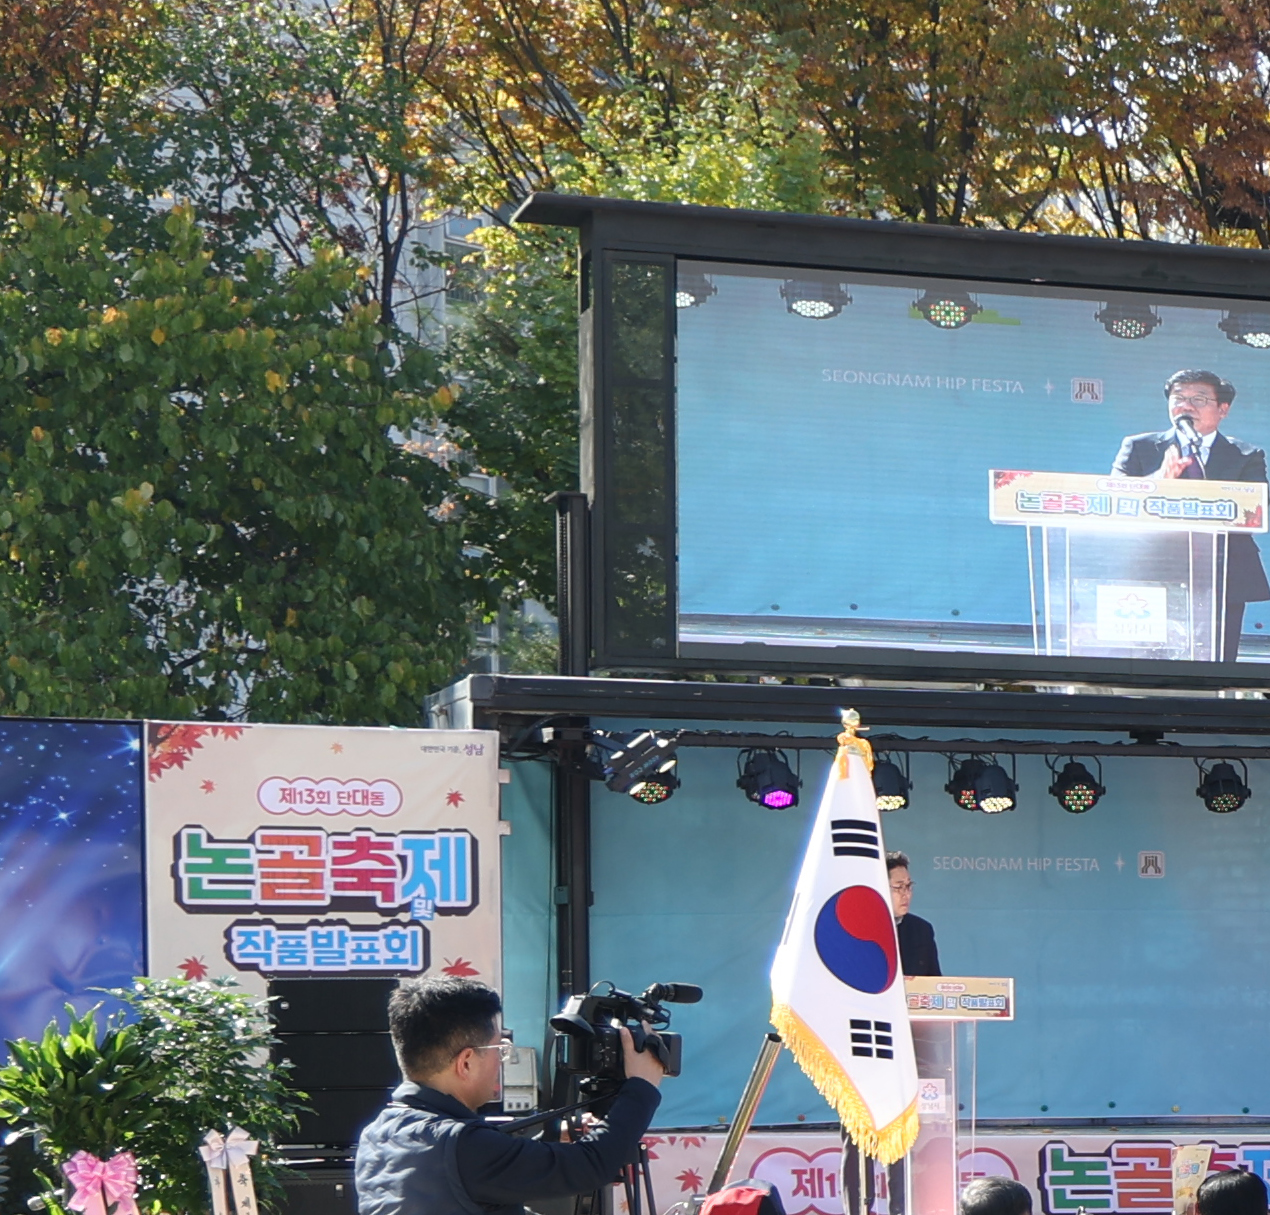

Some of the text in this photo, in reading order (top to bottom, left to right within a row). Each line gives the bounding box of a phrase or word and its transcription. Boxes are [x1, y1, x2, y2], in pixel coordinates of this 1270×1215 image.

[821, 368, 1024, 394] SEONGNAM HIP FESTA
[1019, 493, 1109, 515] 논골축제
[1150, 500, 1232, 518] 작품발표회
[463, 743, 485, 757] 성남
[279, 787, 386, 807] 제13회 단대동
[184, 832, 467, 904] 논골축제
[932, 856, 1100, 872] SEONGNAM HIP FESTA
[412, 898, 434, 919] 및
[231, 929, 419, 968] 작품발표회
